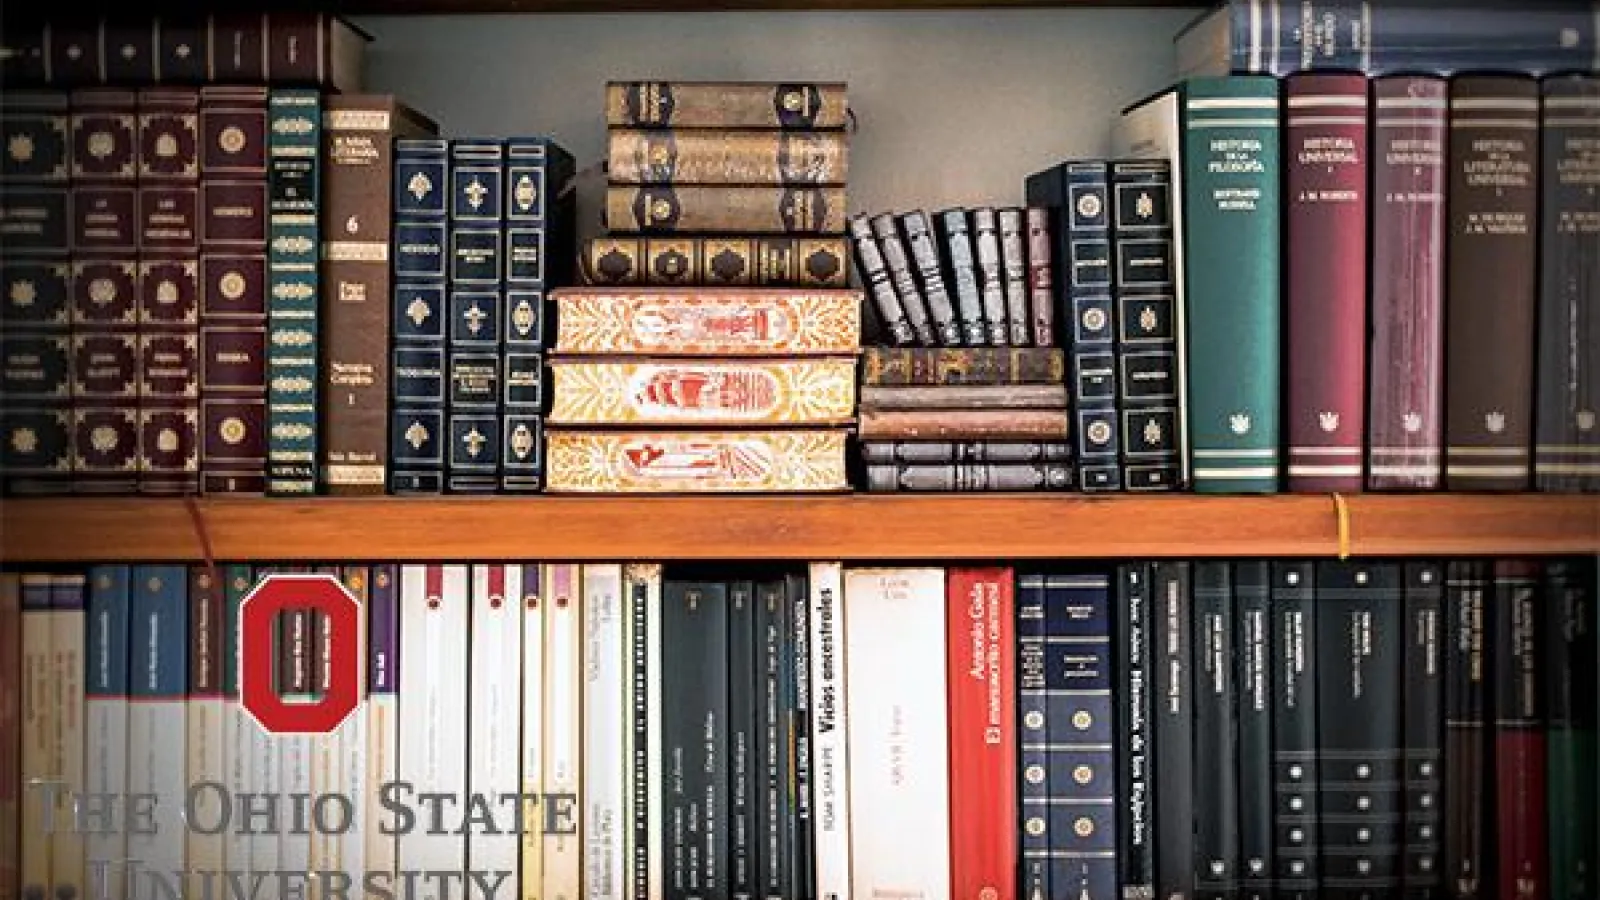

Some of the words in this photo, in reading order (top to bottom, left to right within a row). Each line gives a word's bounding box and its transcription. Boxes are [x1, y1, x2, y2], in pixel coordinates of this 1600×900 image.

[815, 587, 834, 682] ancestrales
[969, 620, 985, 680] Antonio
[818, 686, 836, 733] Vicios
